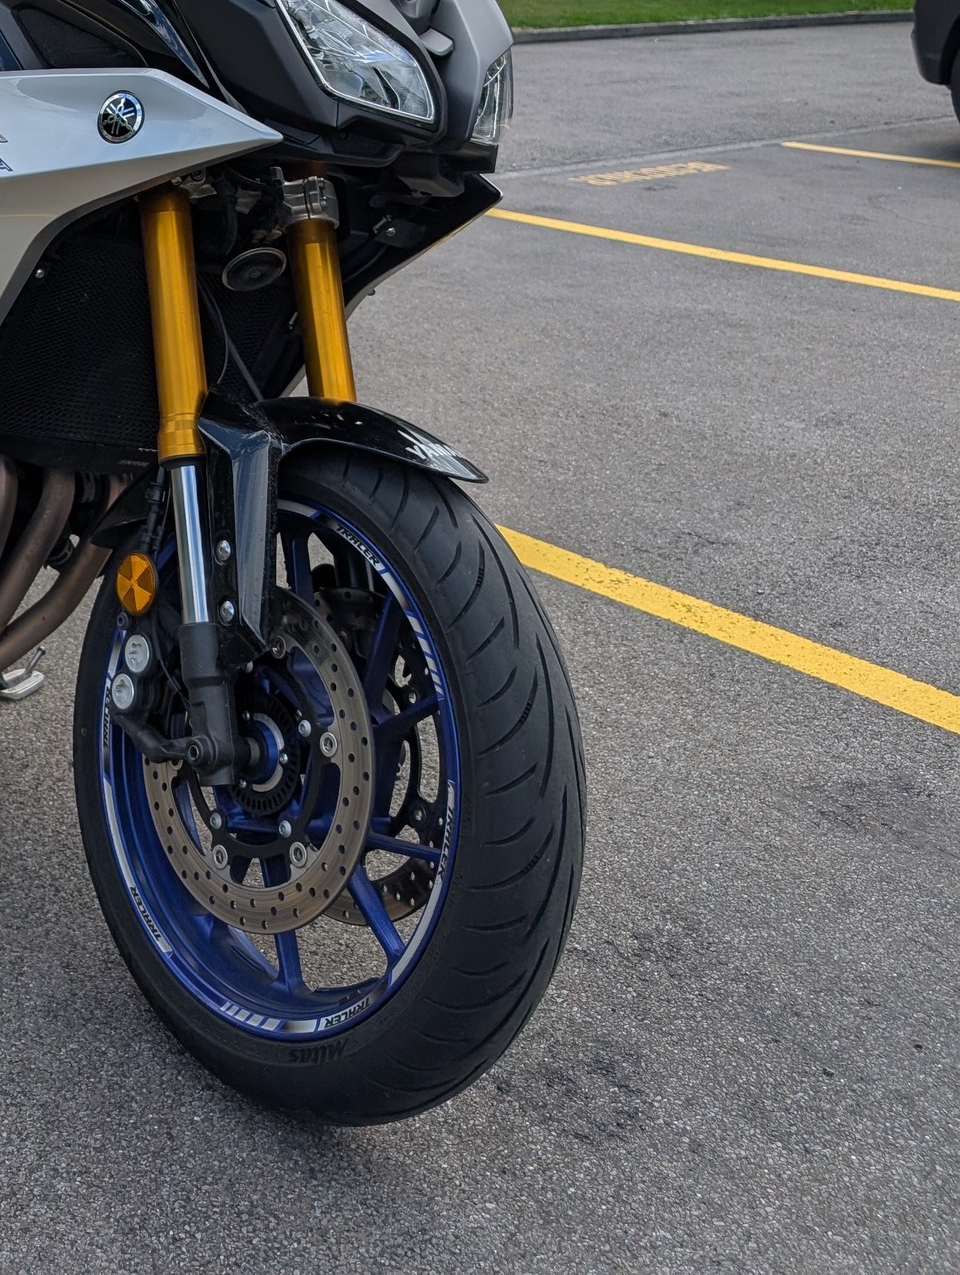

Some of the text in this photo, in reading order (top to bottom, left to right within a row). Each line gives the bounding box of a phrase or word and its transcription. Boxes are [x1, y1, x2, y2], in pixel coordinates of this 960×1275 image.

[336, 525, 381, 567] TRACER
[129, 886, 162, 942] TRACER
[323, 996, 371, 1029] TRACER
